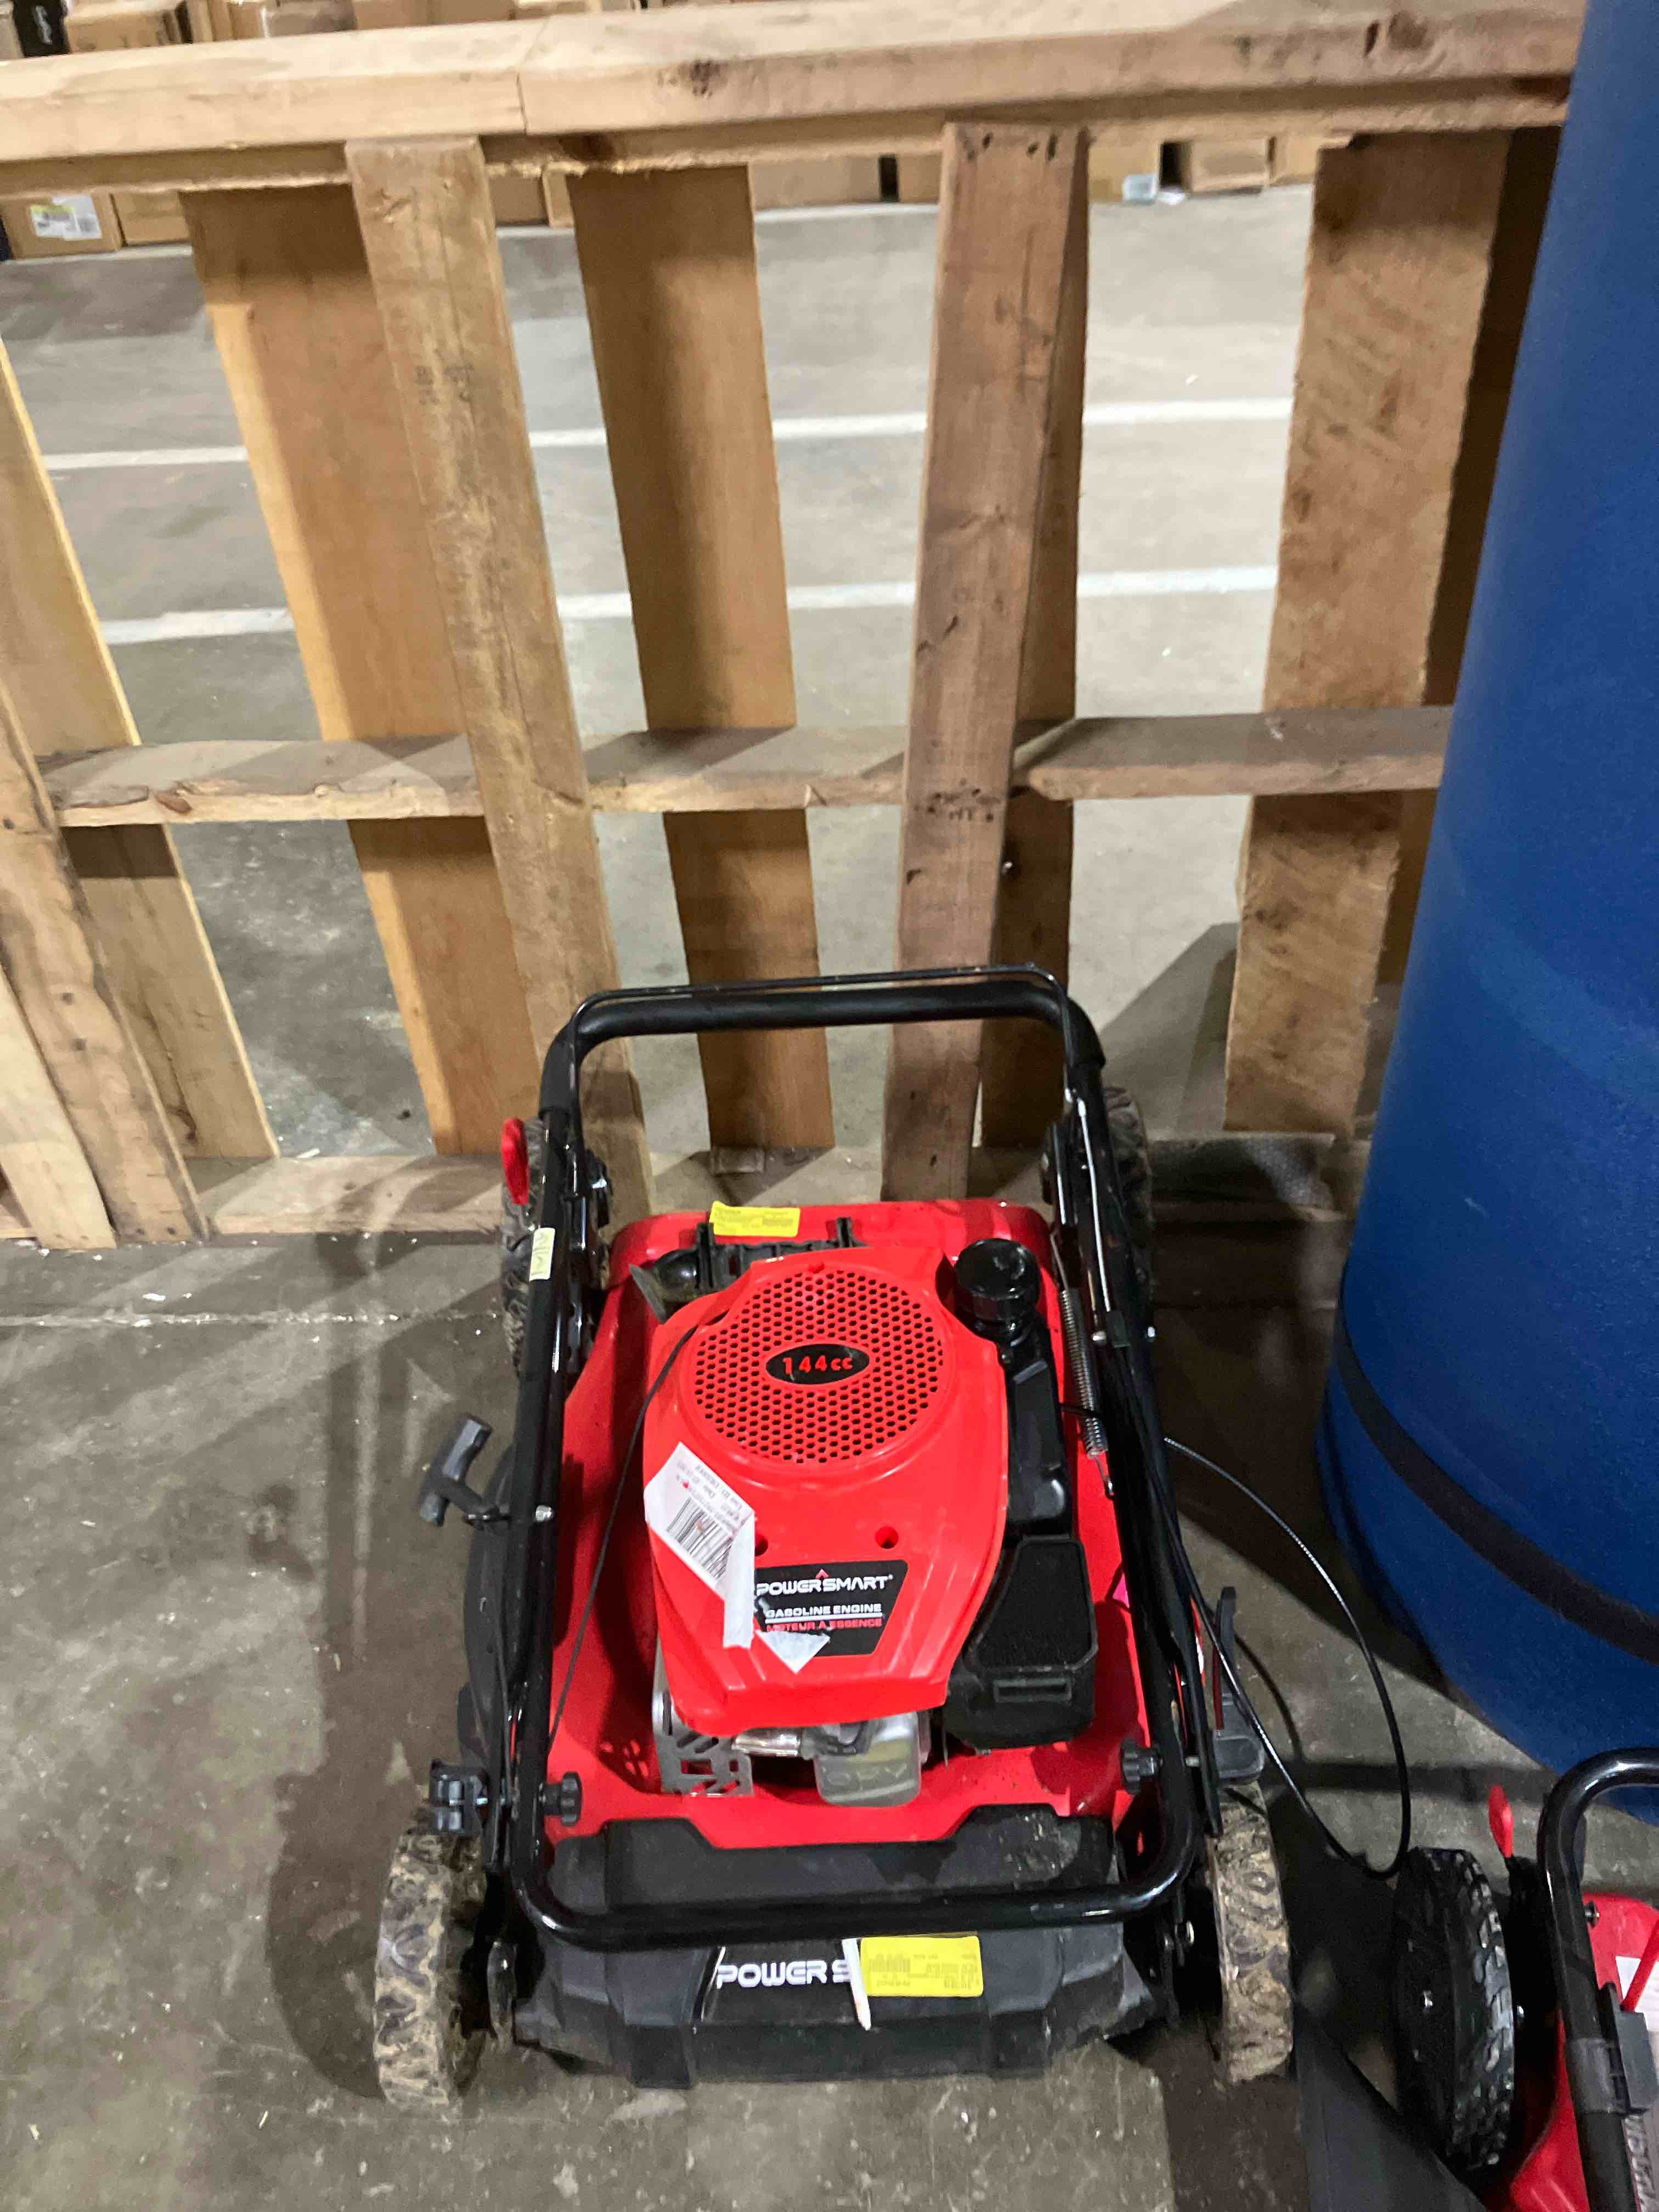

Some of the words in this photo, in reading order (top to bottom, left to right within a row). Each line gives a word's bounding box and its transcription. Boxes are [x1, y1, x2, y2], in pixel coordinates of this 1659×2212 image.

[782, 1355, 853, 1375] 144cc
[756, 1576, 889, 1596] POWERSMART
[766, 1606, 831, 1618] GASOLINE
[833, 1603, 882, 1614] ENGINE
